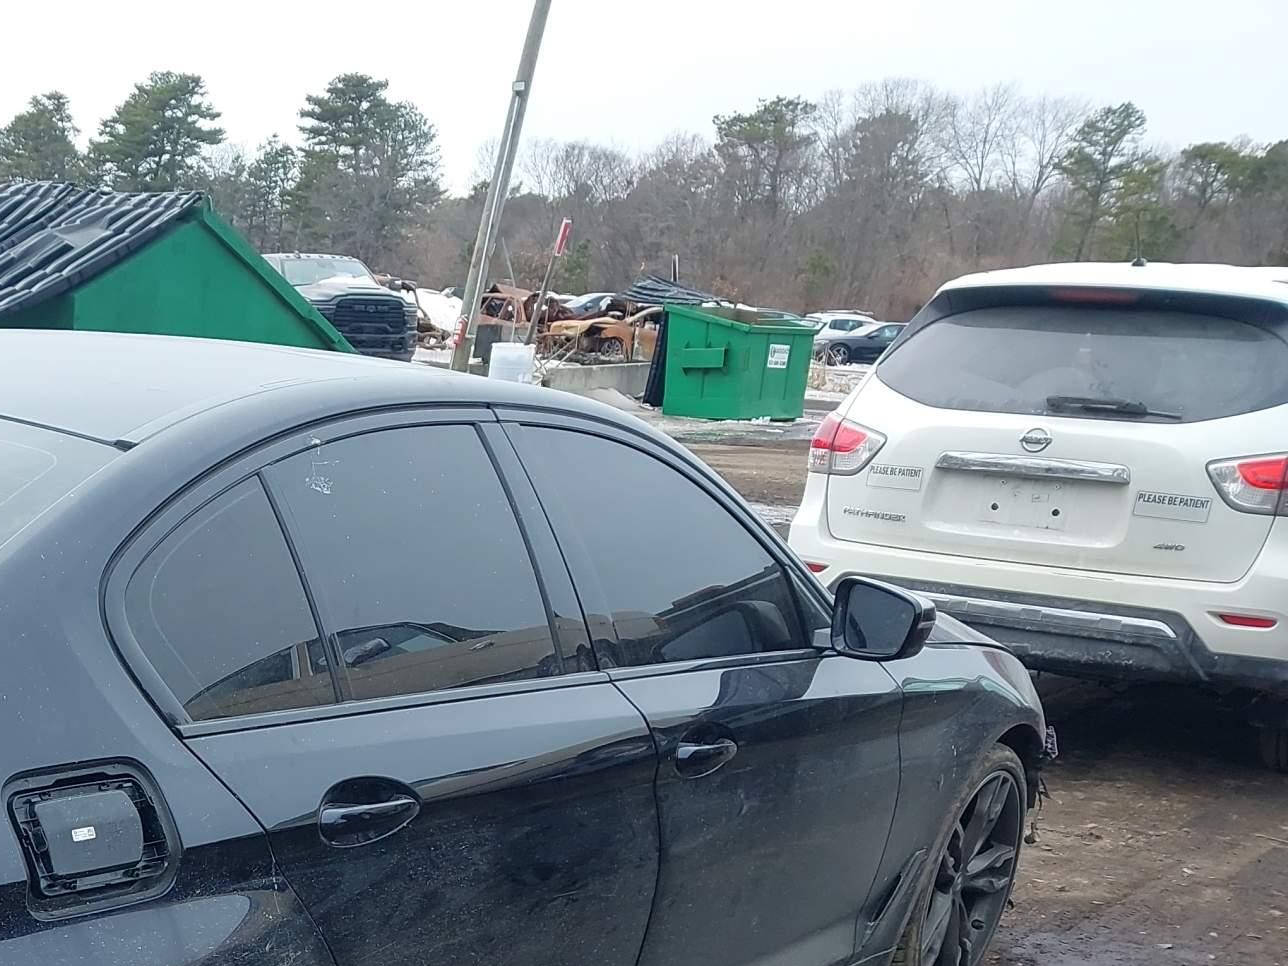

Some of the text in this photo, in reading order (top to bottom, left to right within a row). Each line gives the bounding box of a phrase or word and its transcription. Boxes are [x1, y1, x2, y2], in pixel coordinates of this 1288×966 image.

[870, 465, 922, 478] PLEASE BE PATIENT
[1137, 493, 1210, 509] PLEASE BE PATIENT
[843, 507, 906, 522] PATHFINDER
[1153, 544, 1185, 552] 4WD
